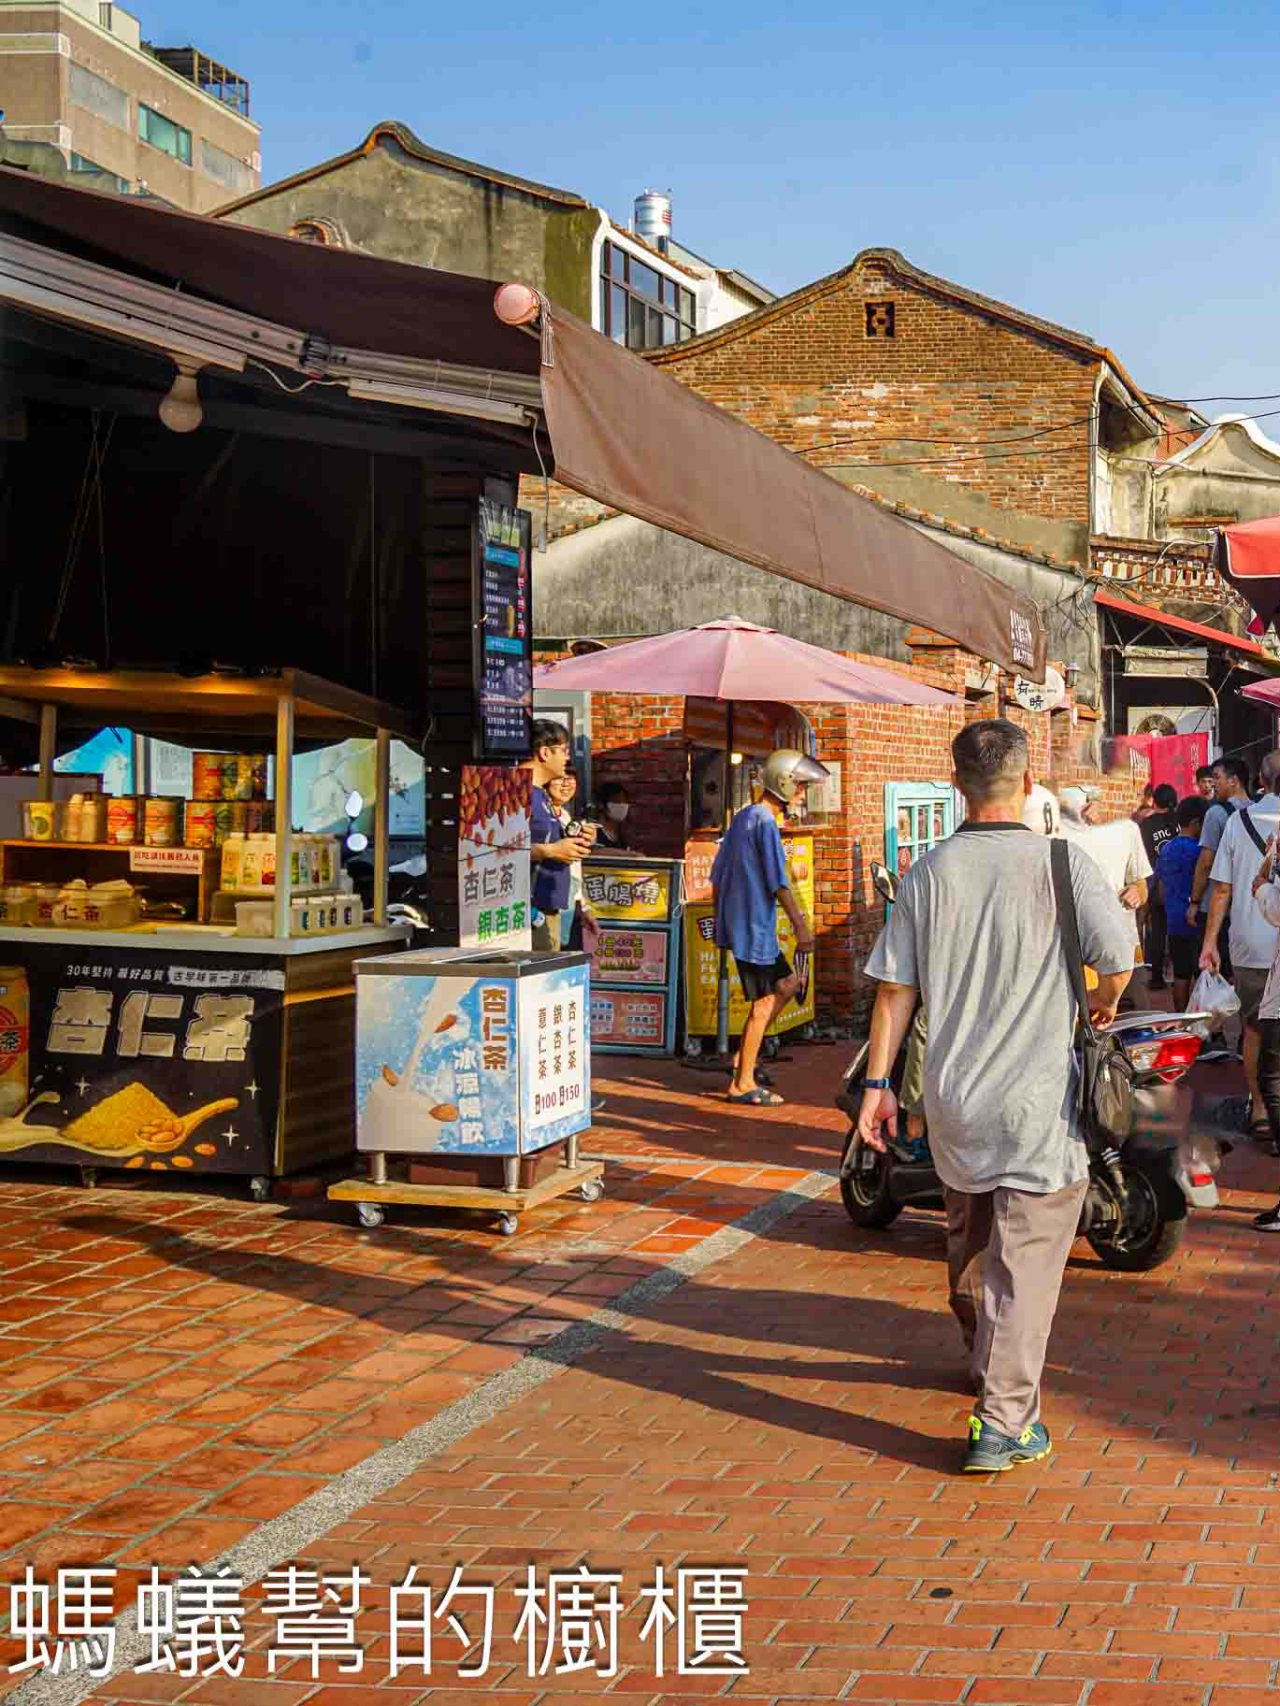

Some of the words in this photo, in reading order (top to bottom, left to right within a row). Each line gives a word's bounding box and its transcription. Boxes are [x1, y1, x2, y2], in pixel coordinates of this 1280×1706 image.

[463, 862, 515, 905] 杏仁茶
[478, 900, 527, 943] 銀杏茶
[481, 986, 508, 1072] 杏仁茶
[553, 1003, 562, 1075] 銀杏茶
[567, 1000, 577, 1071] 杏仁茶
